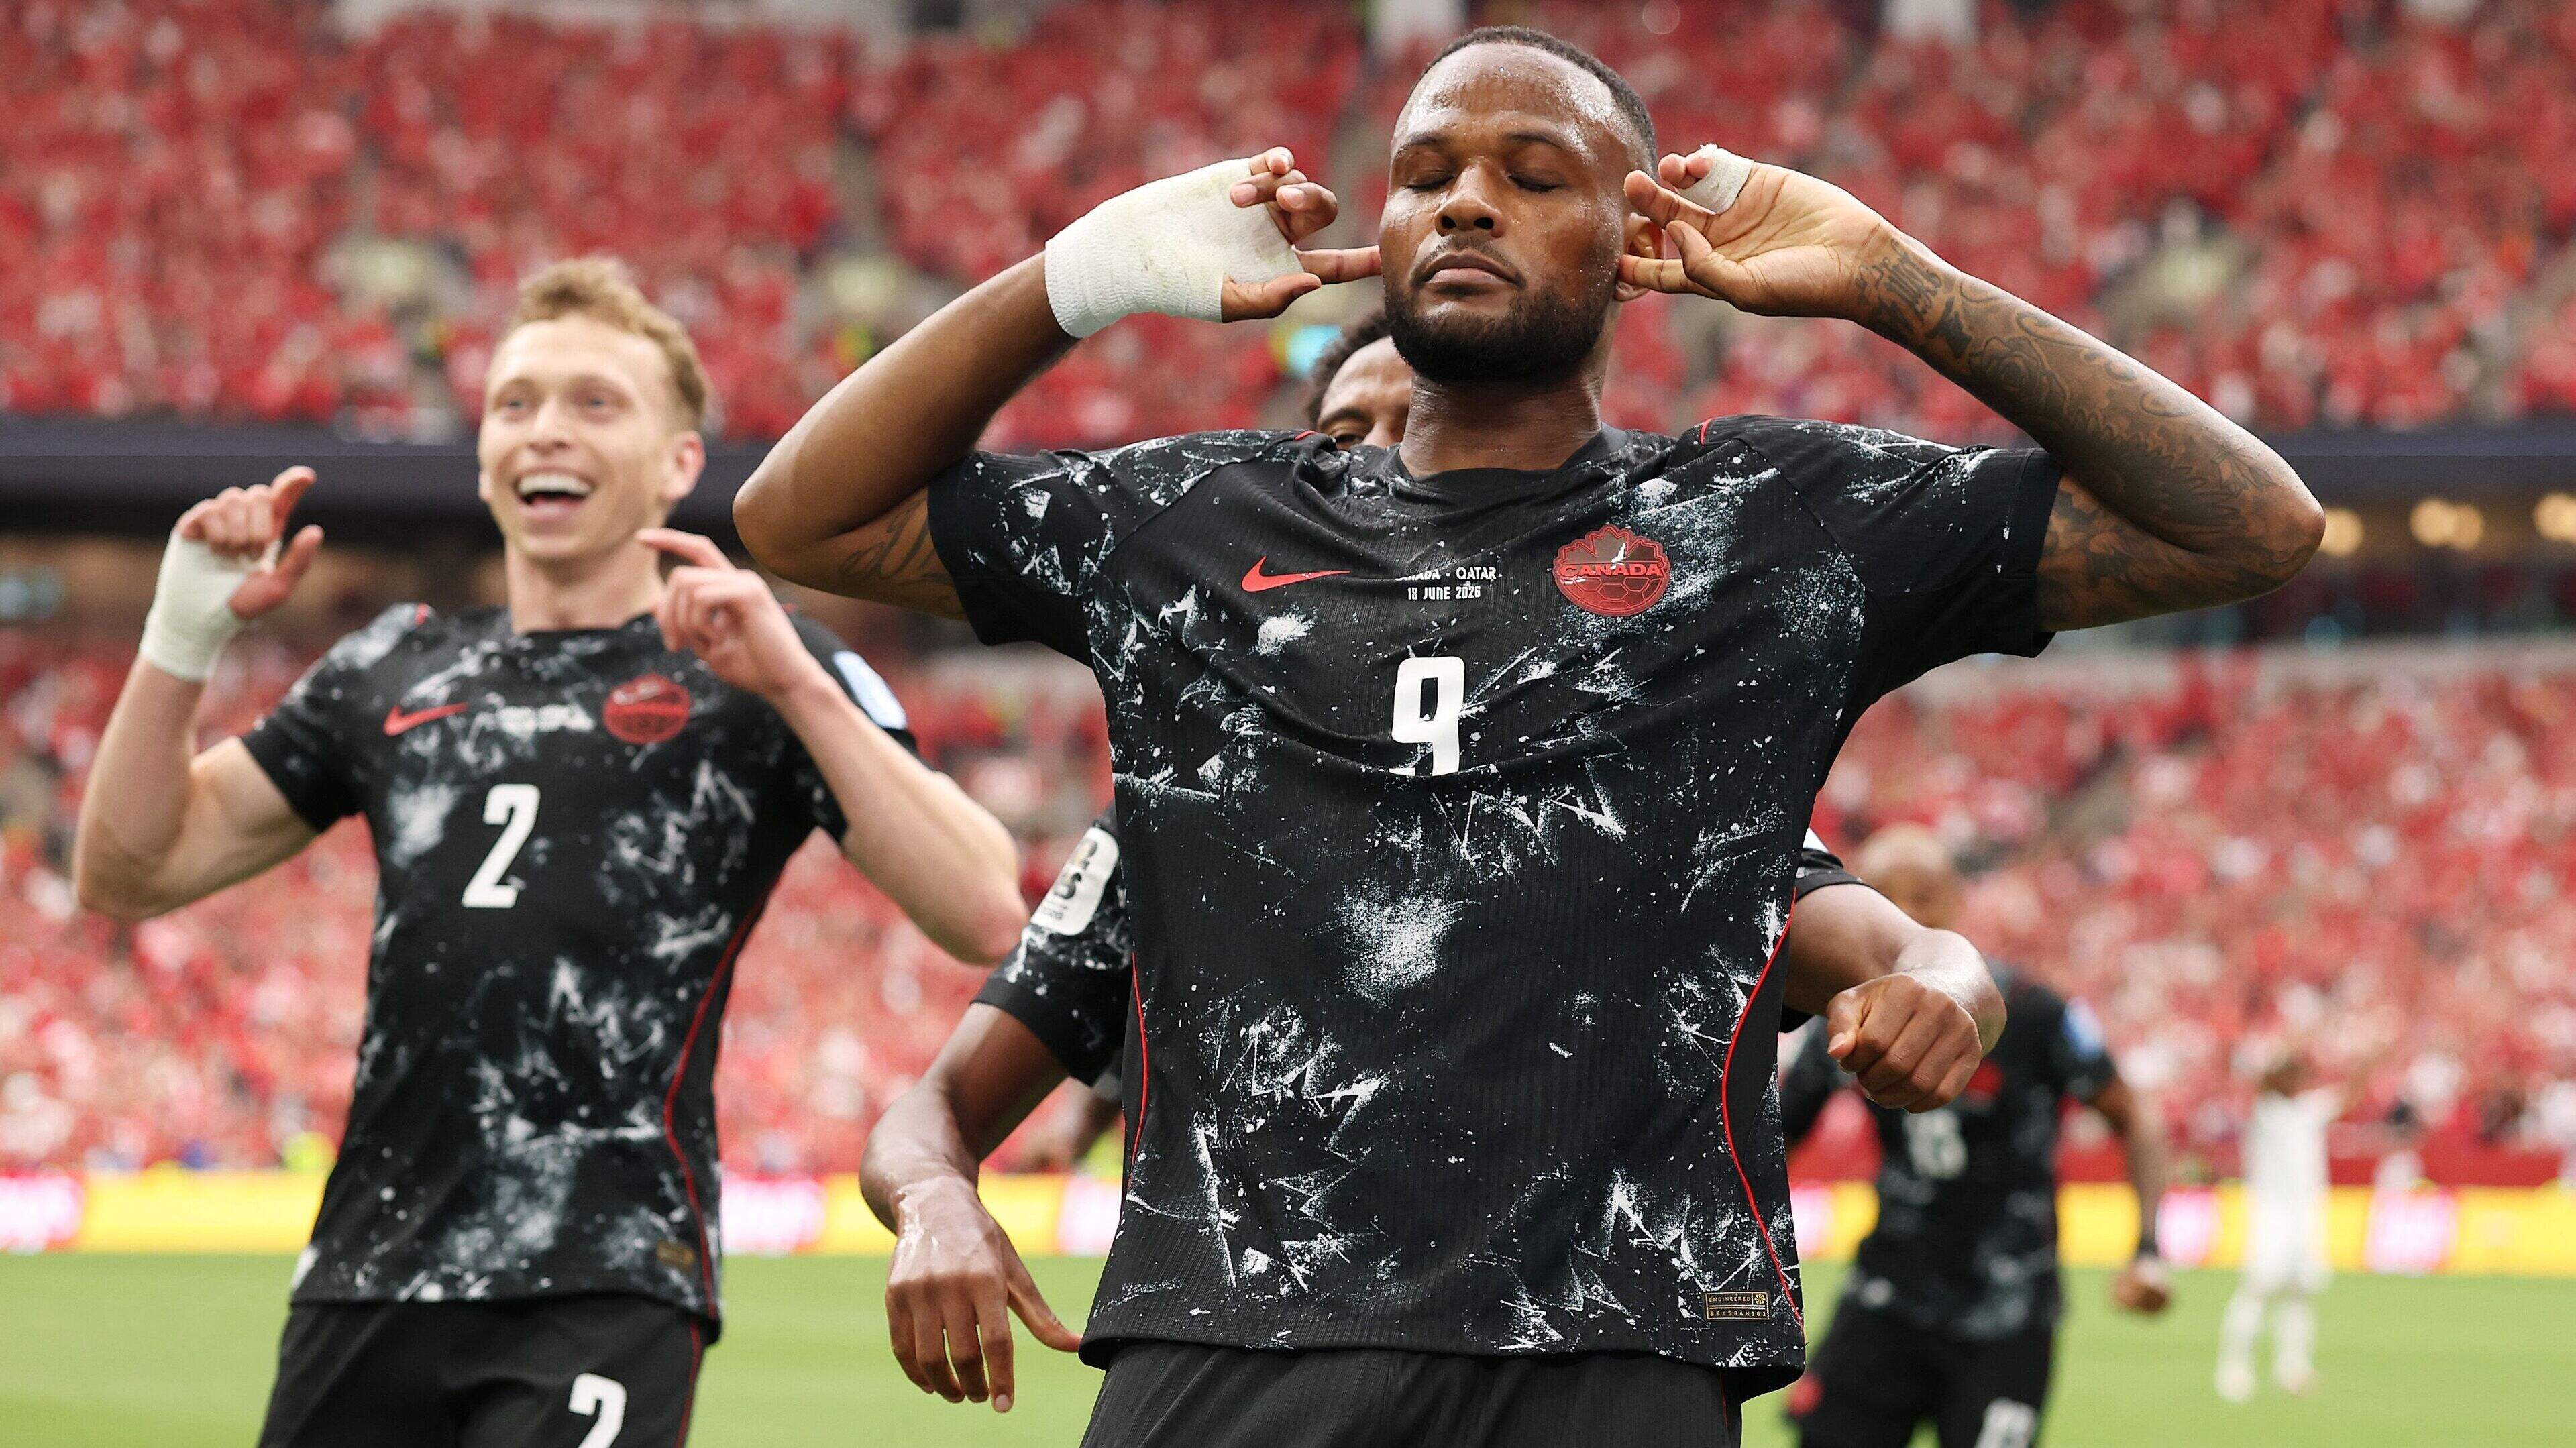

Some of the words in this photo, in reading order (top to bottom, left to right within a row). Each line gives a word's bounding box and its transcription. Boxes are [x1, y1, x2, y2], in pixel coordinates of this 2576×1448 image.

[1456, 566, 1497, 580] QATAR
[1560, 563, 1663, 577] CANADA
[1407, 587, 1418, 600] 18
[1422, 586, 1450, 600] JUNE
[1455, 586, 1481, 600] 2026
[1391, 657, 1465, 776] 9
[462, 783, 541, 908] 2
[568, 1373, 627, 1448] 2
